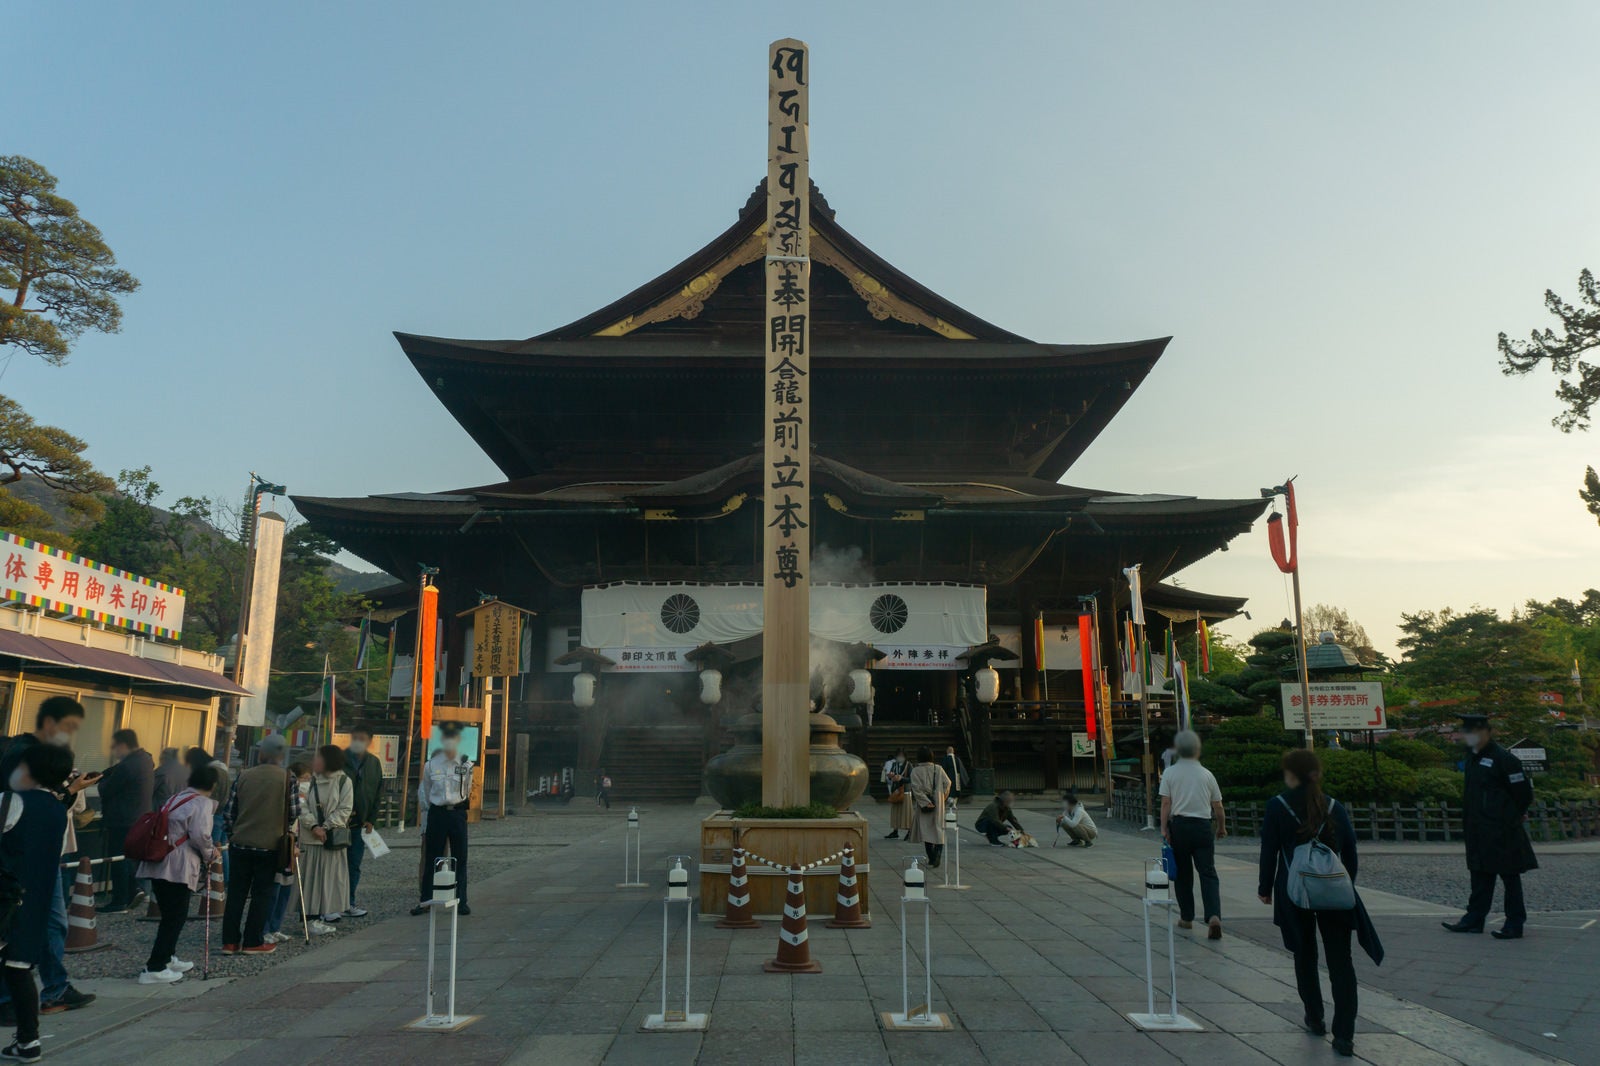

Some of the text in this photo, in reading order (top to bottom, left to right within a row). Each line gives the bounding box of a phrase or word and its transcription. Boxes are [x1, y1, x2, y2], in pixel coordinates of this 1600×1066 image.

[4, 552, 168, 621] 体専用御朱印所
[892, 648, 949, 660] 外陣参拝
